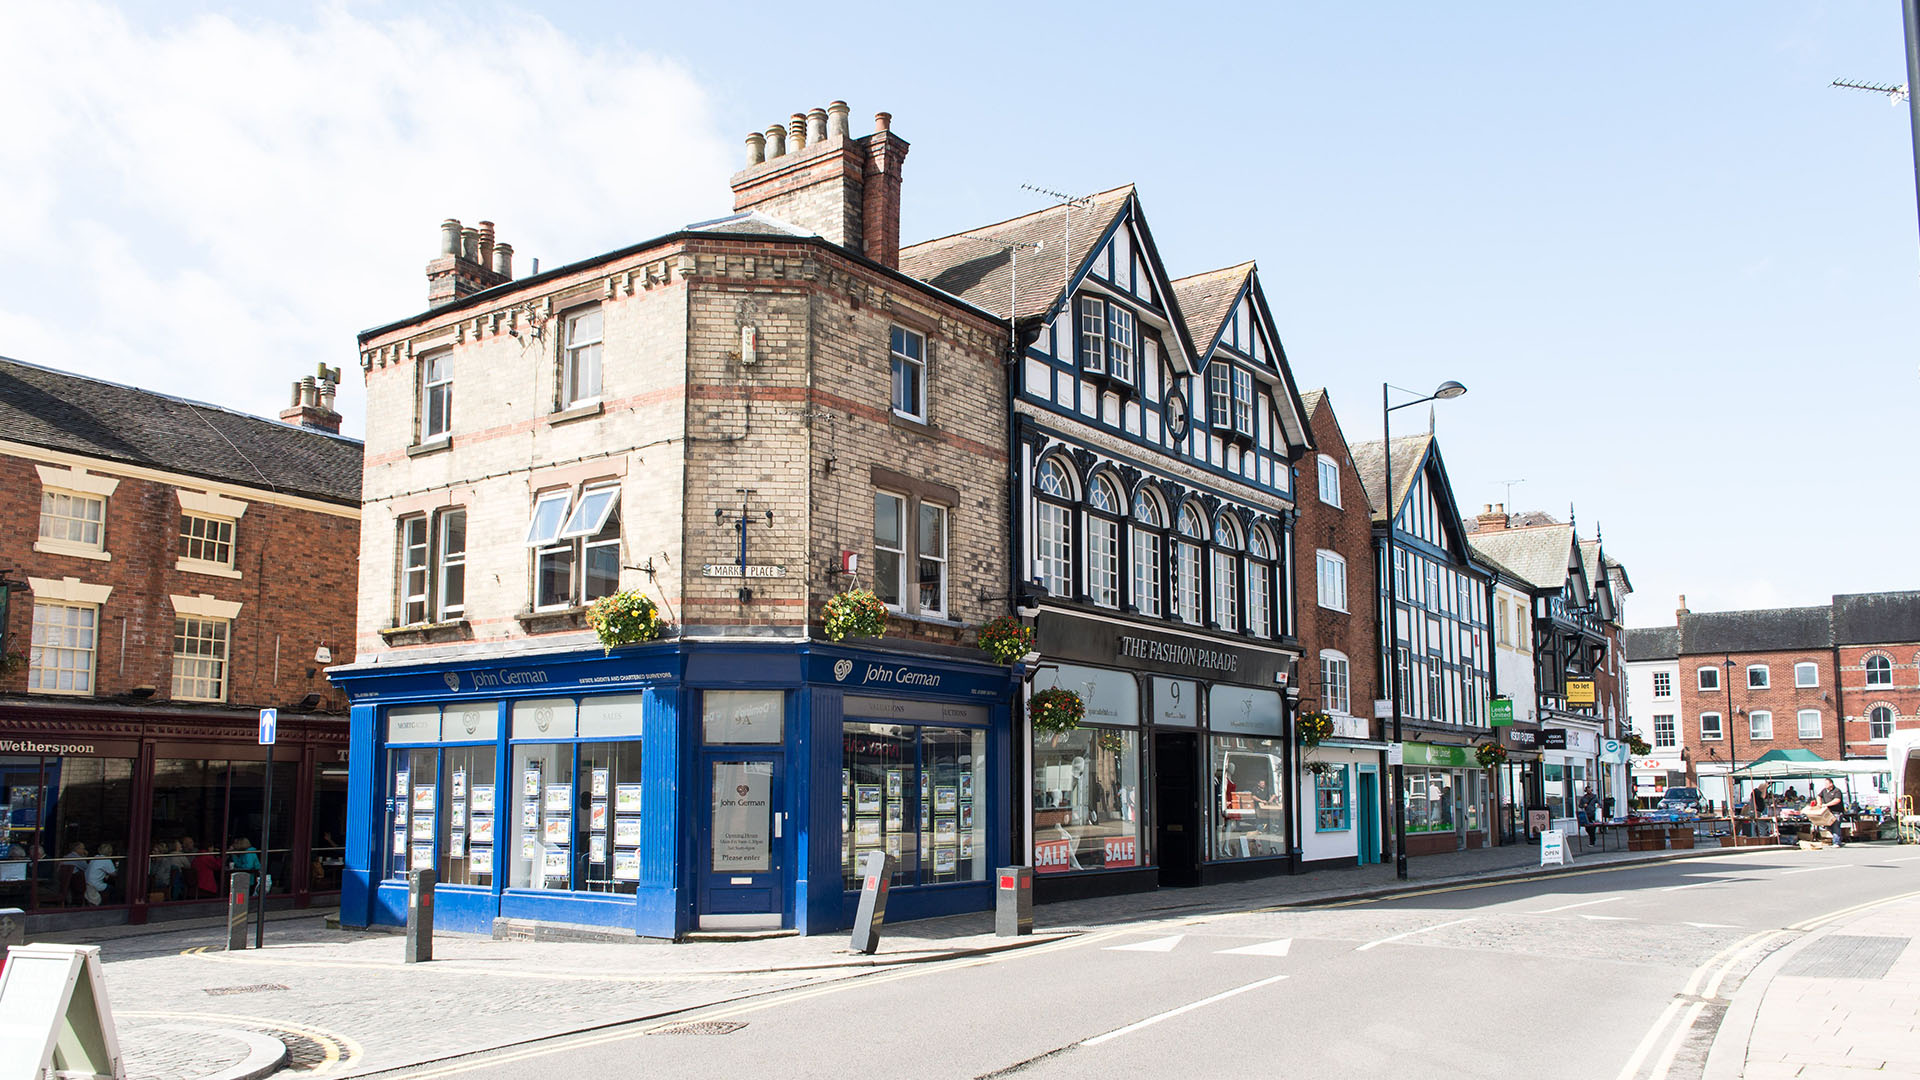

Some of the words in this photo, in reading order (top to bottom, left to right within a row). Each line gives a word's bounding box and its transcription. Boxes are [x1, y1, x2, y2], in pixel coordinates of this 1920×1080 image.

[714, 566, 748, 576] MARKE
[750, 566, 774, 577] PLACE
[1123, 636, 1148, 658] THE
[1149, 641, 1196, 665] FASHION
[1196, 648, 1238, 672] PARADE
[470, 671, 499, 692] John
[500, 668, 549, 685] German
[862, 663, 892, 684] John
[895, 667, 941, 687] German
[1171, 681, 1180, 709] 9
[0, 740, 95, 756] Wetherspoon
[720, 799, 736, 808] John
[737, 798, 766, 807] German
[1035, 845, 1067, 867] SALE
[1105, 842, 1134, 863] SALE
[1544, 849, 1560, 857] OPEN
